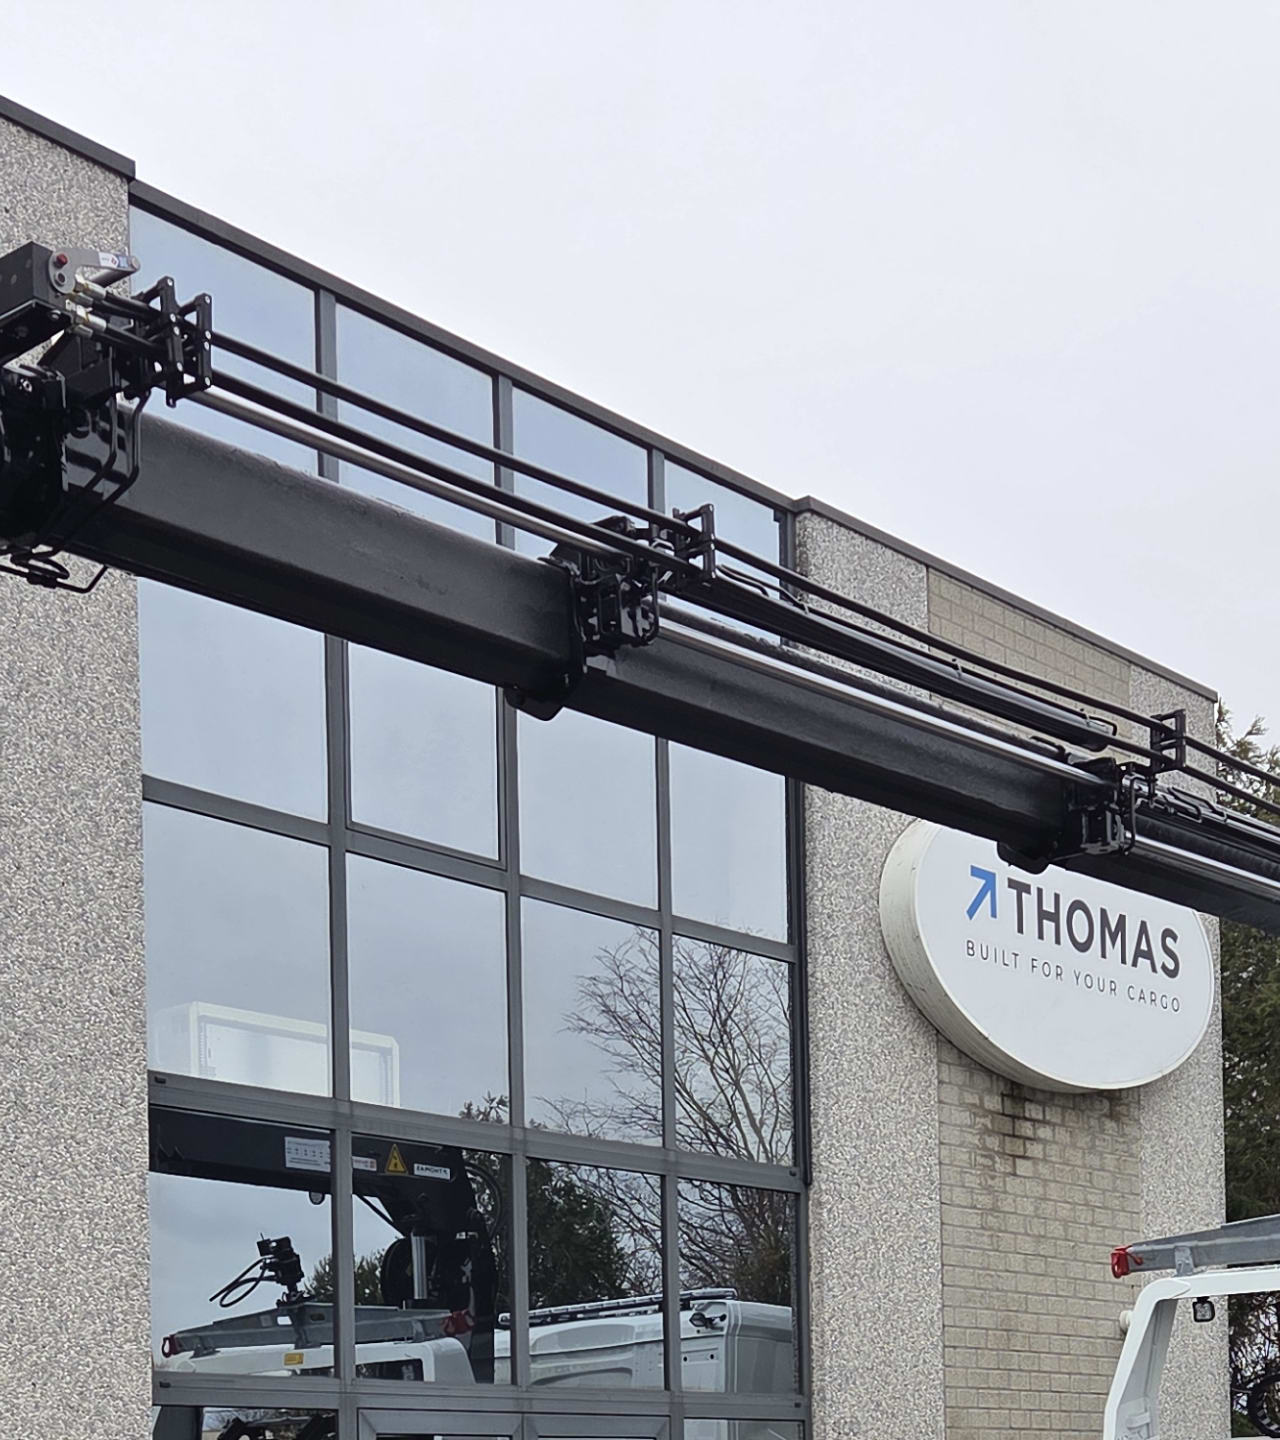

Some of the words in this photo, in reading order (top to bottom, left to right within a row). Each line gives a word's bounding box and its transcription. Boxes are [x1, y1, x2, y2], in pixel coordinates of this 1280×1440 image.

[1007, 877, 1180, 979] THOMAS
[966, 939, 1019, 970] BUILT
[1031, 958, 1064, 982] FOR
[1074, 969, 1117, 997] YOUR
[1127, 985, 1180, 1013] CARGO
